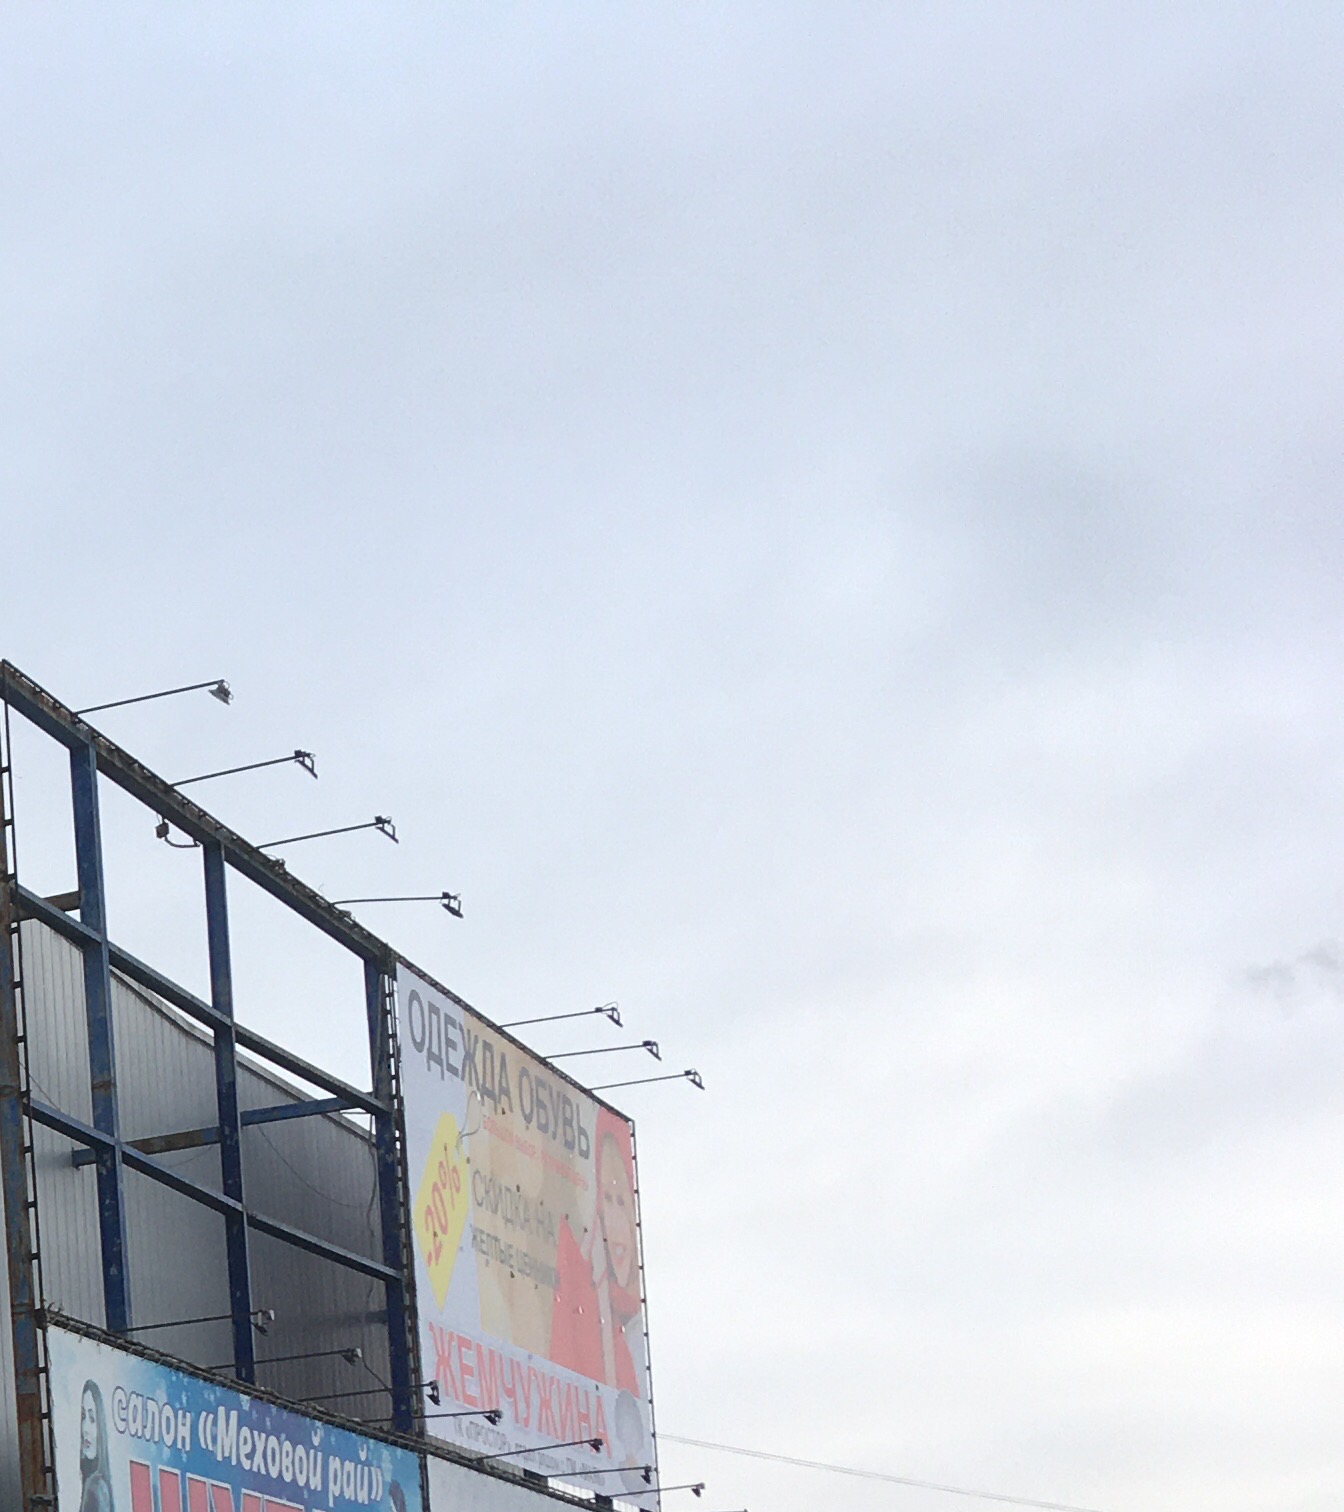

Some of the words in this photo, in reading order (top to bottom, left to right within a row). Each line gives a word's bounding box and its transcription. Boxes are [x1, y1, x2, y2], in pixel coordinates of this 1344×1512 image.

[407, 989, 513, 1114] ОДЕЖДА
[518, 1066, 590, 1160] ОБУВЬ
[113, 1386, 191, 1453] салон
[198, 1404, 323, 1492] «Меховой
[327, 1444, 383, 1507] рай»
[429, 1322, 612, 1461] ЖЕМЧУЖИНА
